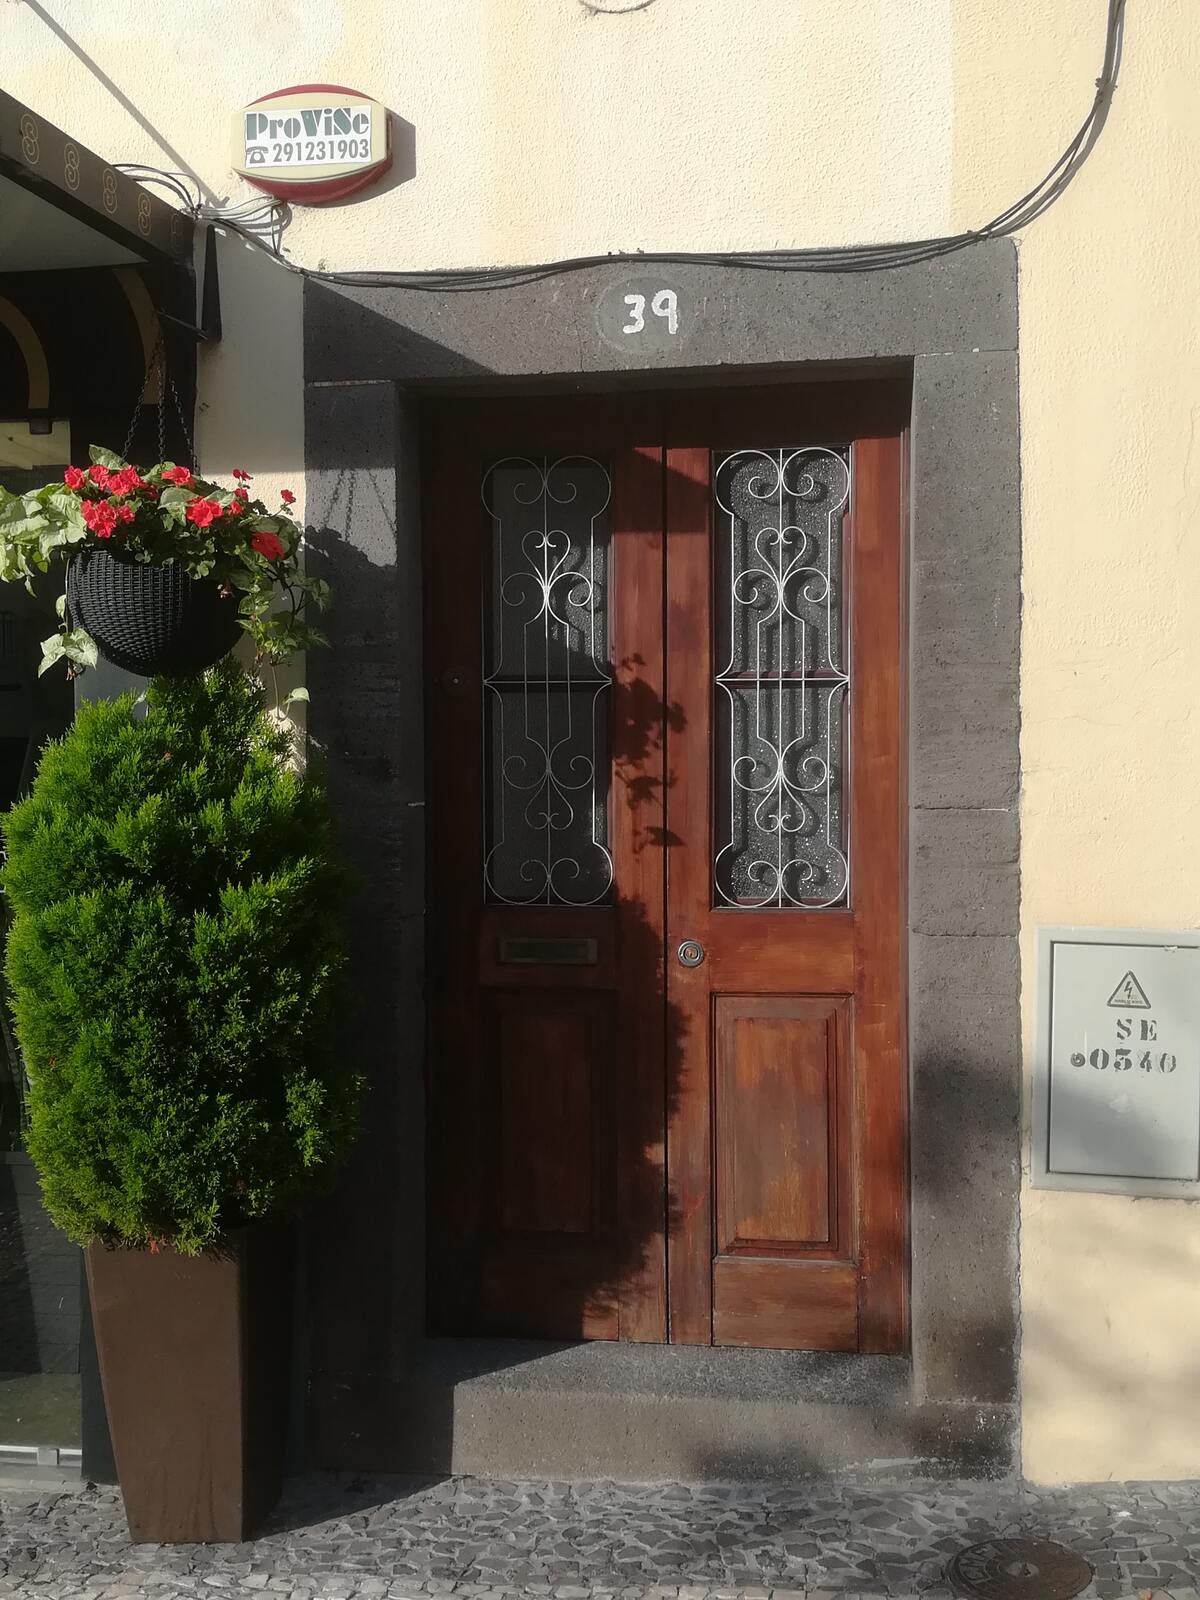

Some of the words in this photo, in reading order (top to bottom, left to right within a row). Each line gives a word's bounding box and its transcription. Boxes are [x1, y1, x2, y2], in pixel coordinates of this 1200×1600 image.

[246, 107, 369, 140] ProViSe
[273, 138, 369, 163] 291231903
[622, 289, 678, 335] 39
[1116, 1018, 1157, 1041] SE
[1089, 1048, 1177, 1073] 0540
